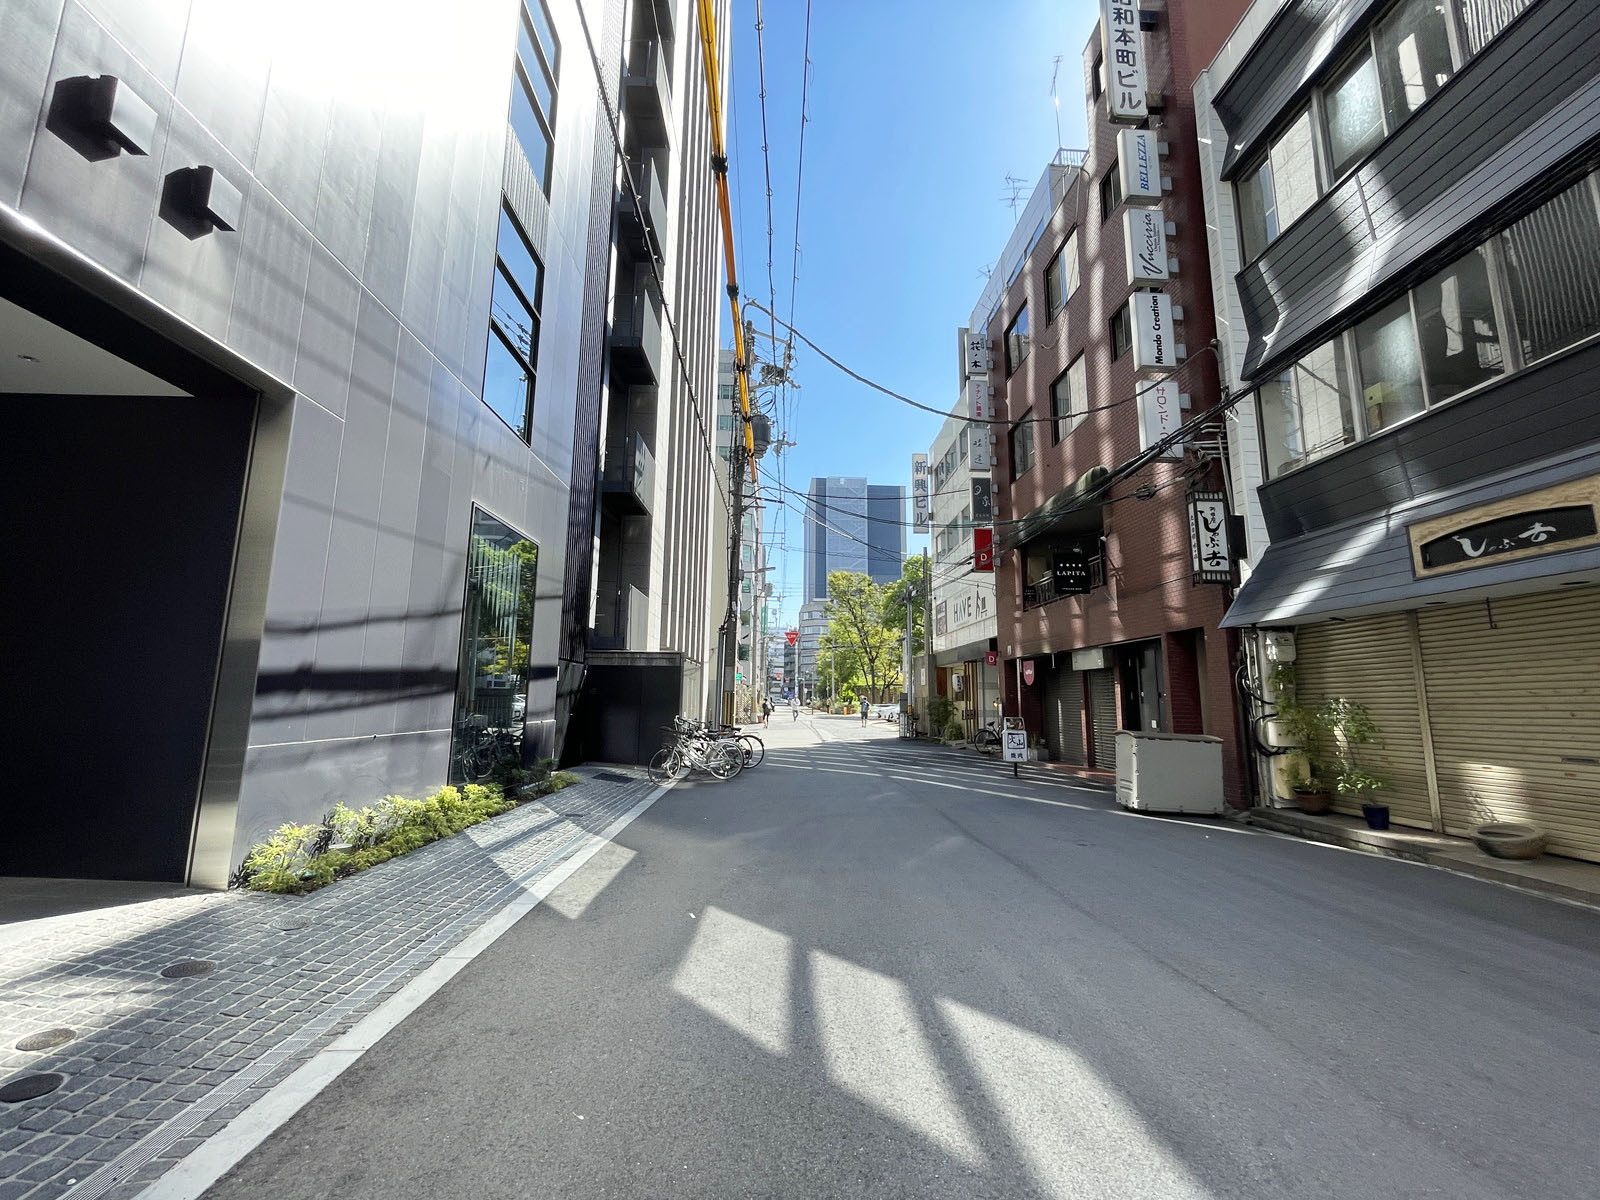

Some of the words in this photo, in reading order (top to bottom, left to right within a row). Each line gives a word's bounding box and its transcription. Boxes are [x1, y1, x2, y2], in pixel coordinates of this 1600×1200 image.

[1136, 134, 1150, 191] BELLEZZA
[1150, 295, 1161, 331] Creation
[1153, 334, 1163, 364] Mondo
[953, 596, 972, 623] HAVE
[988, 655, 995, 663] D
